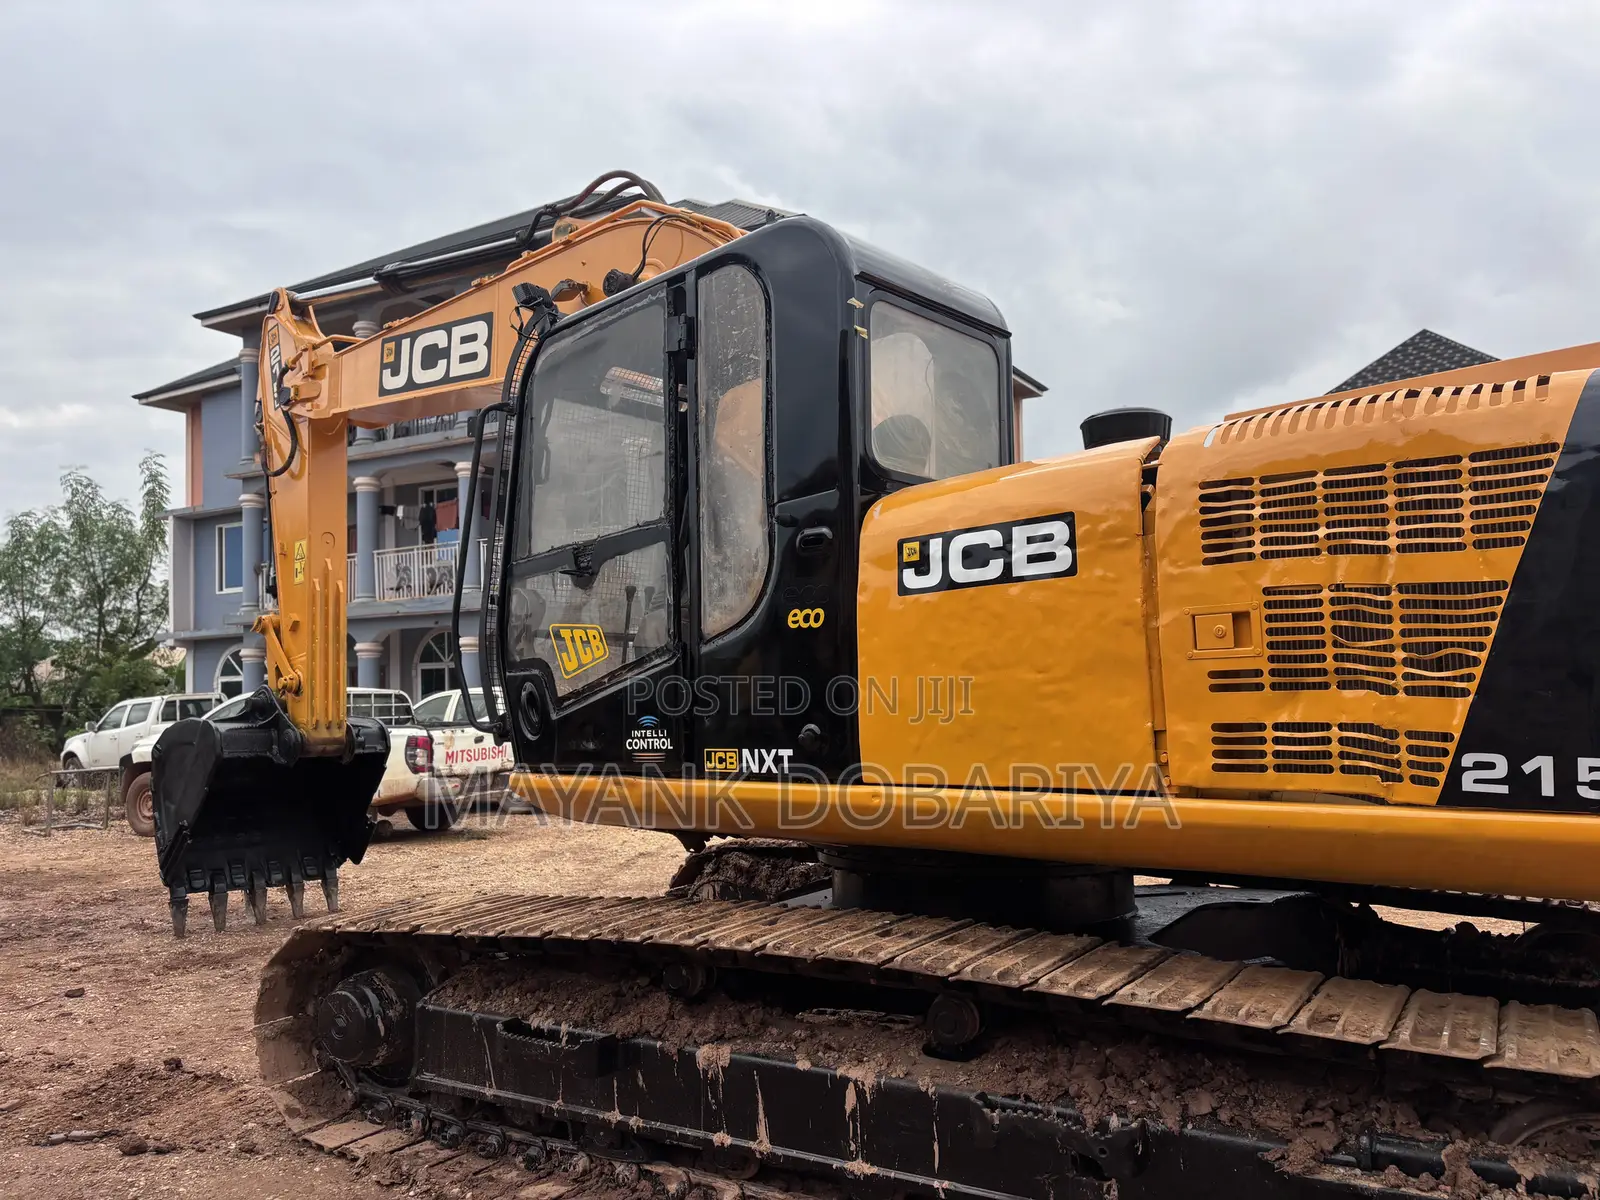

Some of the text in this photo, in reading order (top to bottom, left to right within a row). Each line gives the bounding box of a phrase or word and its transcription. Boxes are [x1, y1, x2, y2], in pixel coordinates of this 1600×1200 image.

[382, 320, 488, 390] JCB
[902, 520, 1073, 589] JCB
[787, 608, 825, 629] eco
[559, 628, 605, 672] JCB
[625, 738, 673, 750] CONTROL
[631, 729, 667, 738] INTELLI
[445, 745, 508, 765] MITSUBISHI
[706, 748, 794, 774] JCB NXT
